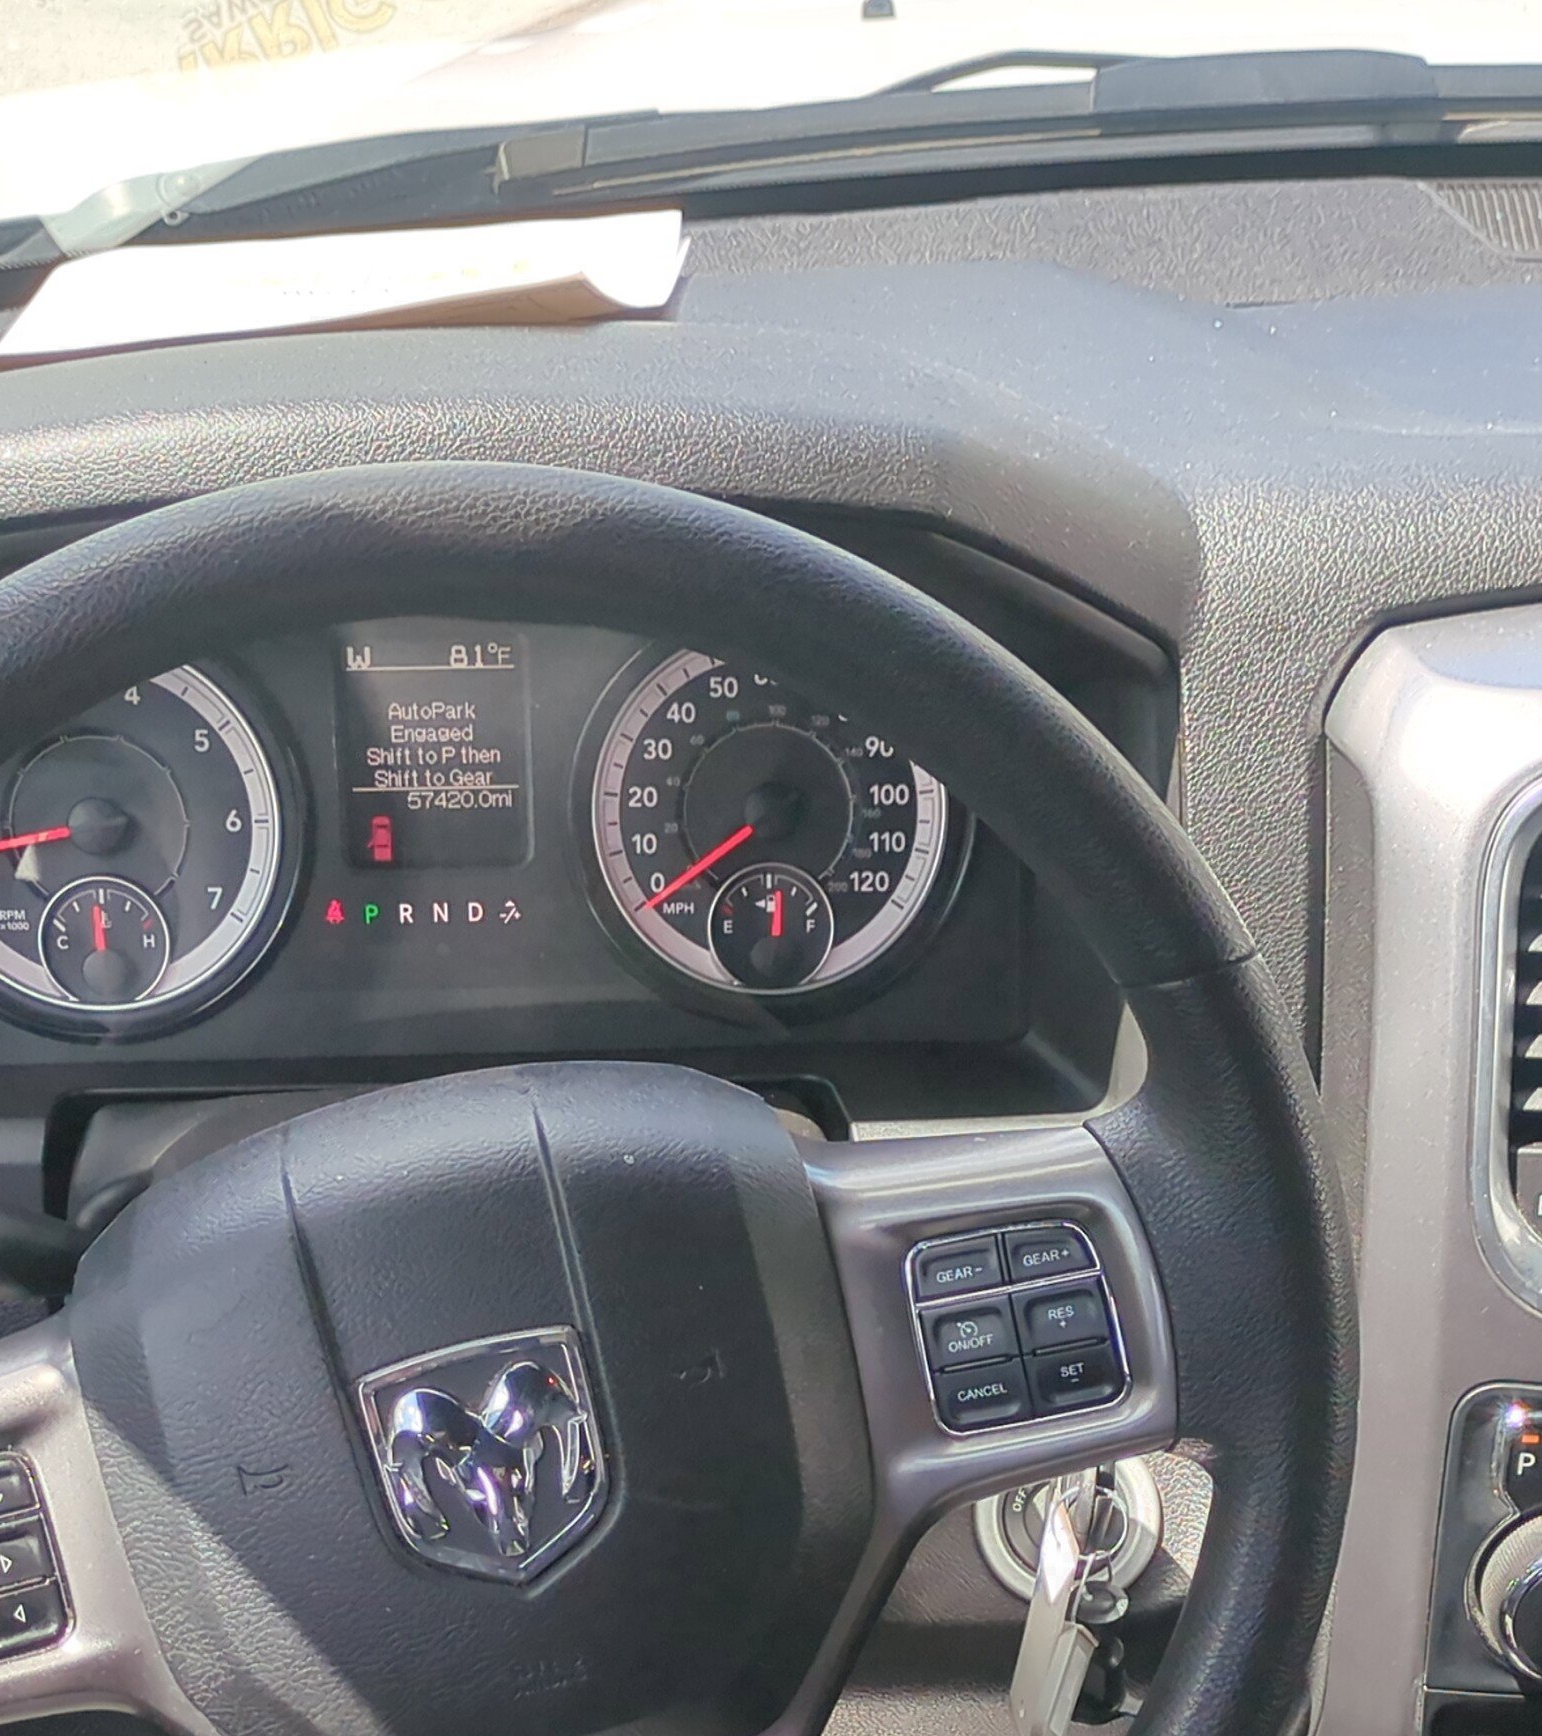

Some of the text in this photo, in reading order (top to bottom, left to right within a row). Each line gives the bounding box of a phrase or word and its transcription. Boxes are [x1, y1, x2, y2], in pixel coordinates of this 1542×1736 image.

[346, 646, 371, 668] W
[124, 685, 141, 705] 4
[709, 676, 739, 699] 50
[387, 702, 476, 721] AutoPark
[666, 701, 696, 725] 40
[194, 729, 210, 753] 5
[390, 725, 473, 744] Engaged
[367, 748, 501, 766] Shift to P then
[643, 738, 672, 762] 30
[374, 769, 493, 789] Shift to Gear
[407, 790, 513, 810] 57420.0mi
[628, 786, 658, 808] 20
[868, 783, 910, 806] 100
[225, 810, 242, 832] 6
[631, 833, 657, 854] 10
[868, 831, 906, 853] 110
[650, 872, 665, 893] 0
[849, 870, 889, 892] 120
[207, 887, 223, 910] 7
[662, 902, 695, 916] MPH
[365, 902, 484, 924] P R N D
[723, 920, 734, 934] E
[806, 919, 816, 933] F
[56, 935, 69, 950] C
[143, 934, 156, 948] H
[1047, 1306, 1075, 1321] RES
[948, 1334, 994, 1353] ON/OFF
[1060, 1363, 1084, 1378] SET
[957, 1382, 1008, 1402] CANCEL
[1517, 1453, 1536, 1476] P
[1012, 1487, 1027, 1512] OFF
